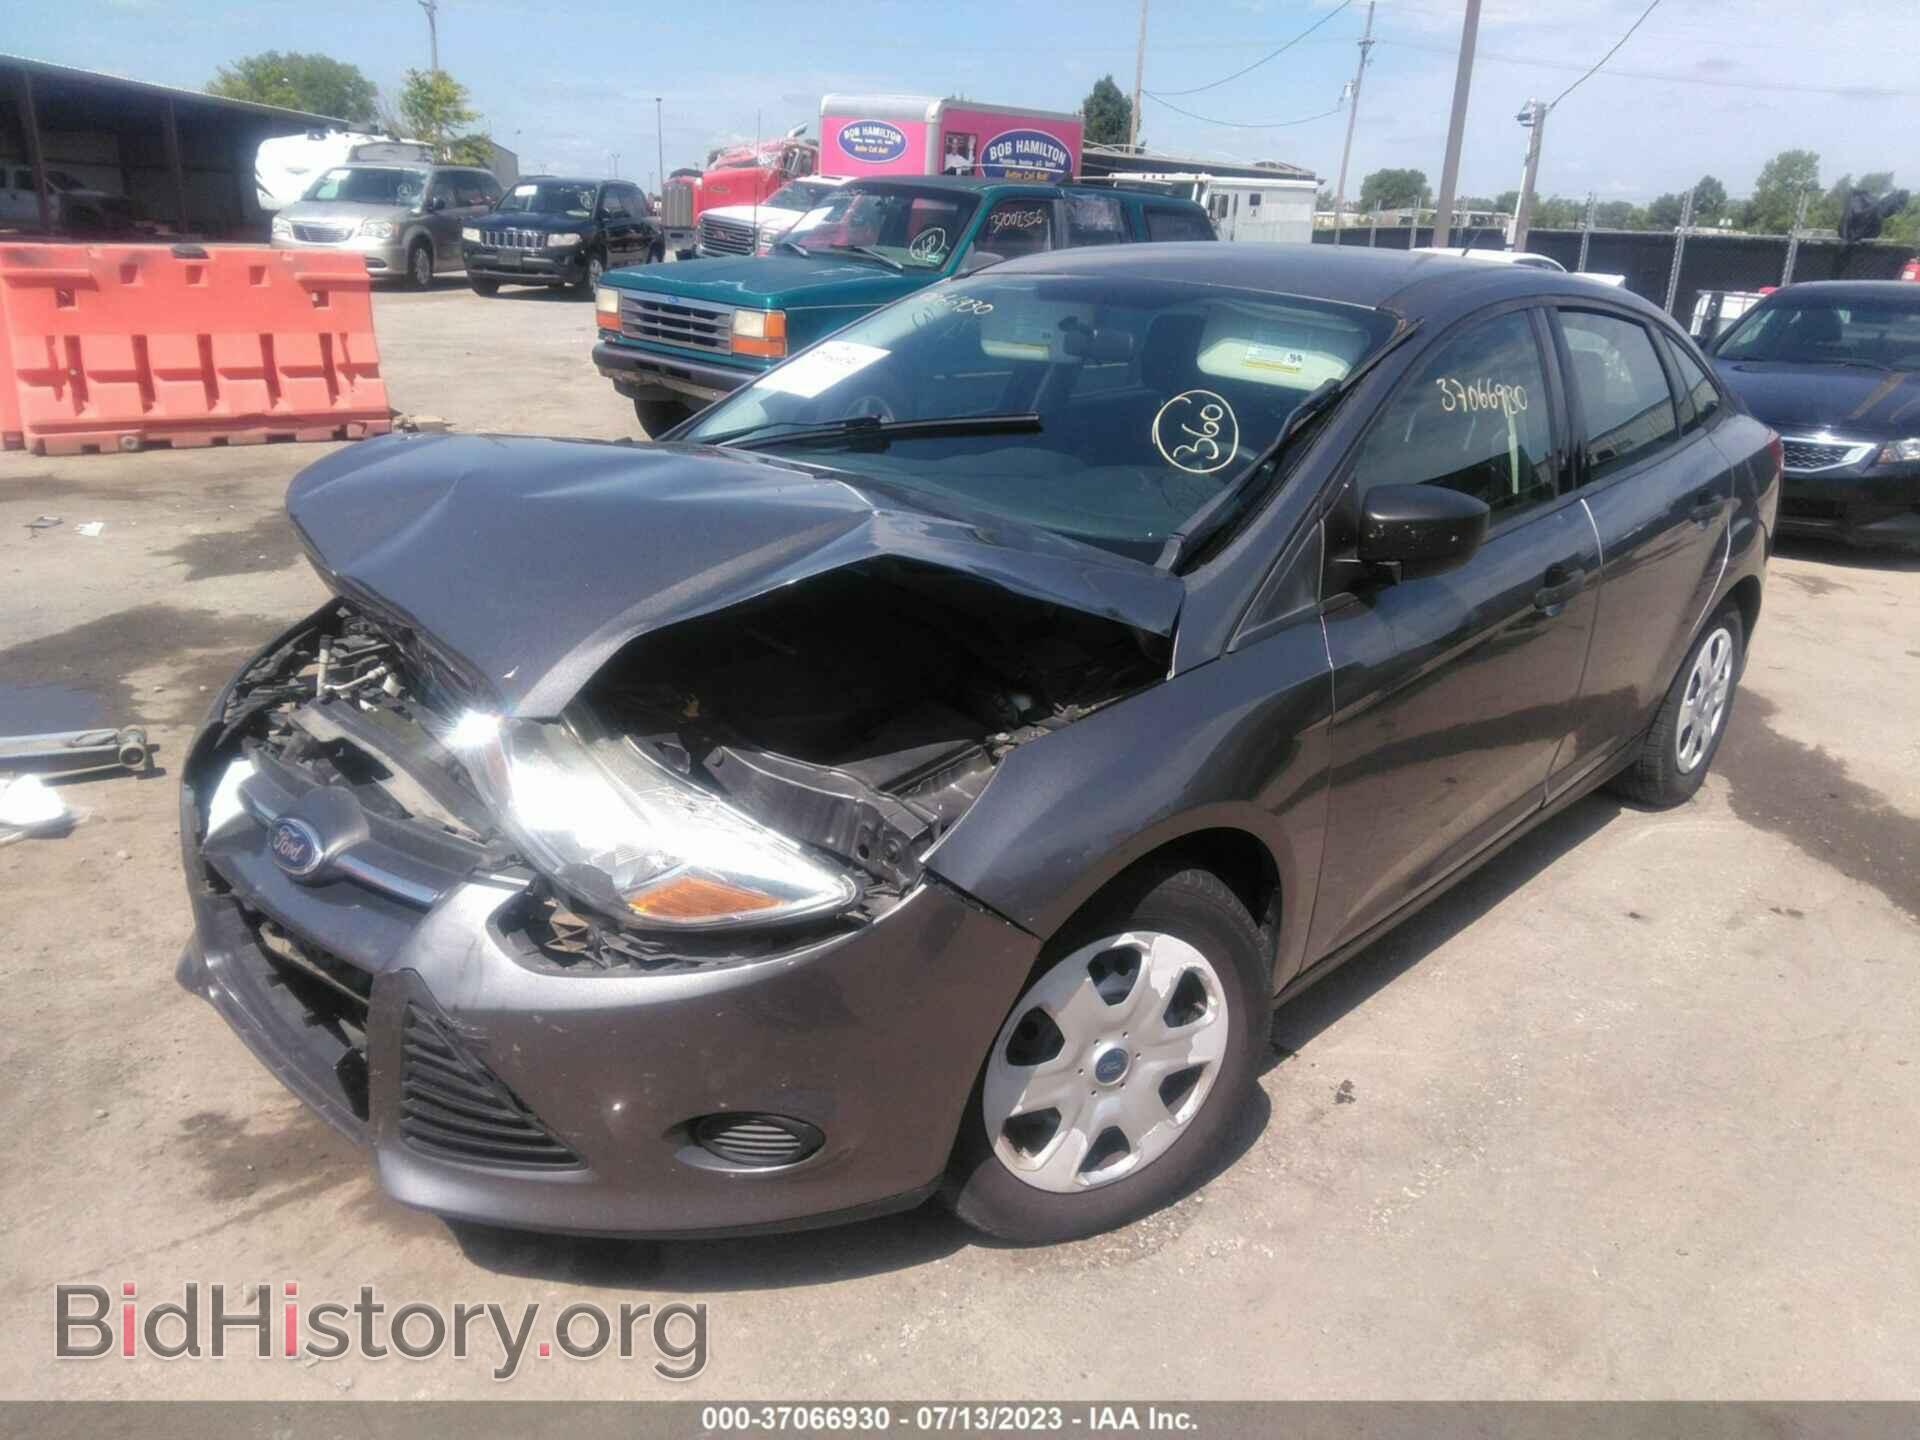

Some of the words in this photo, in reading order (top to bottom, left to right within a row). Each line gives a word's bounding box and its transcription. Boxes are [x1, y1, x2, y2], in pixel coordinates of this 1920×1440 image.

[844, 127, 860, 139] BOB
[862, 126, 901, 144] HAMILTON
[989, 141, 1012, 161] BOB
[1016, 139, 1067, 165] HAMILTON
[1436, 377, 1528, 418] 37066930
[1172, 403, 1224, 460] 360
[273, 825, 305, 860] Ford
